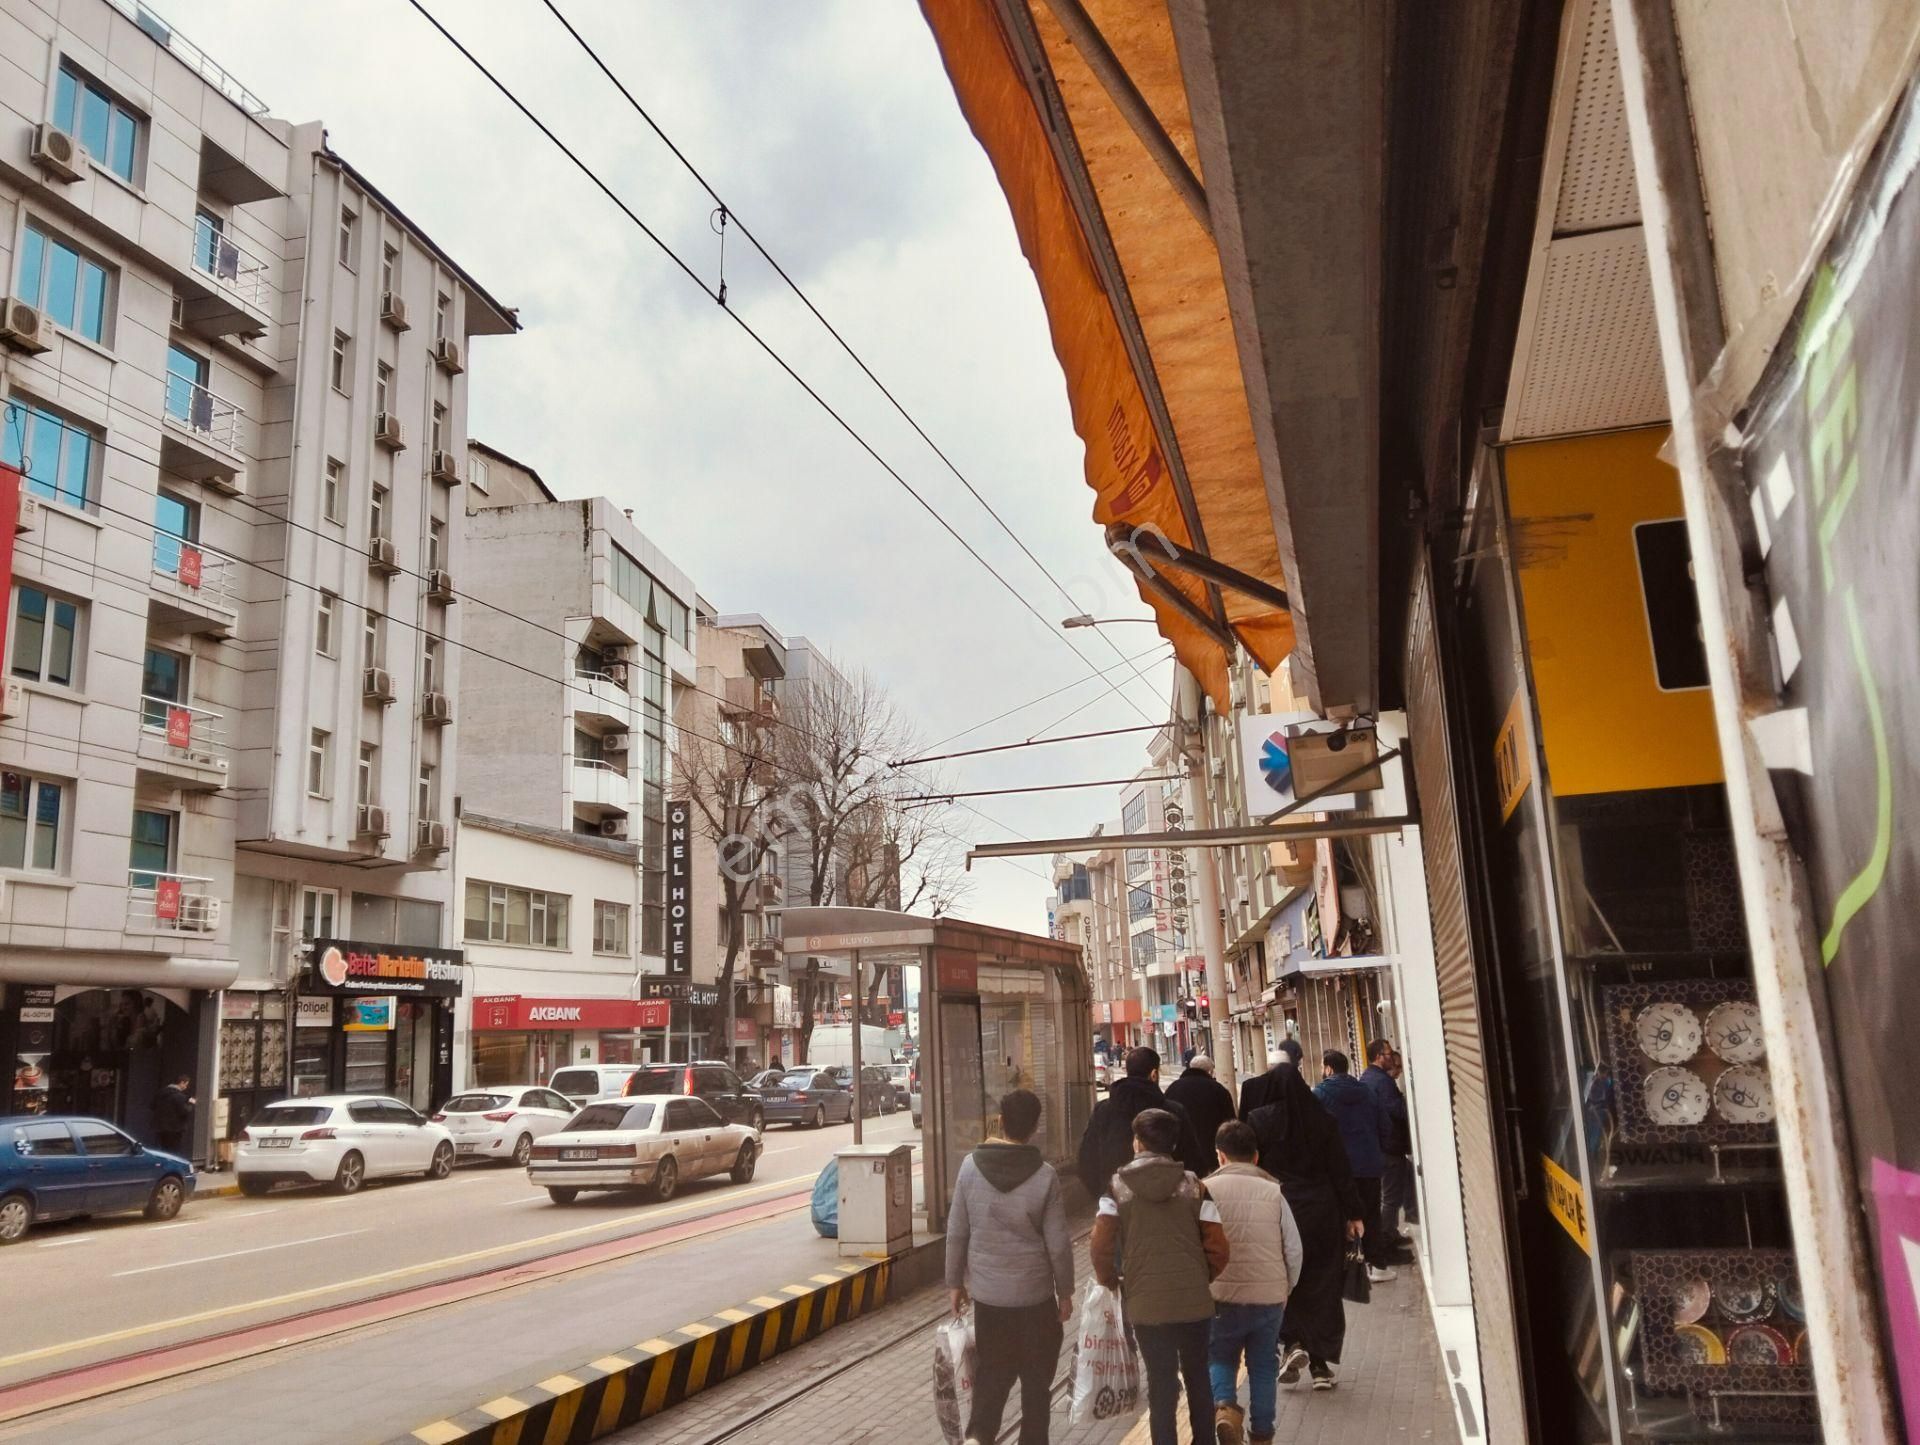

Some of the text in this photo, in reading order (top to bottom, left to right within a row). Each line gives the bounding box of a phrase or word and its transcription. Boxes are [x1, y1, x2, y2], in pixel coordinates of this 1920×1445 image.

[672, 808, 685, 972] ÖNEL HOTEL
[1083, 916, 1094, 970] CEYLAN
[649, 984, 691, 998] HOTE
[529, 1006, 582, 1021] AKBANK
